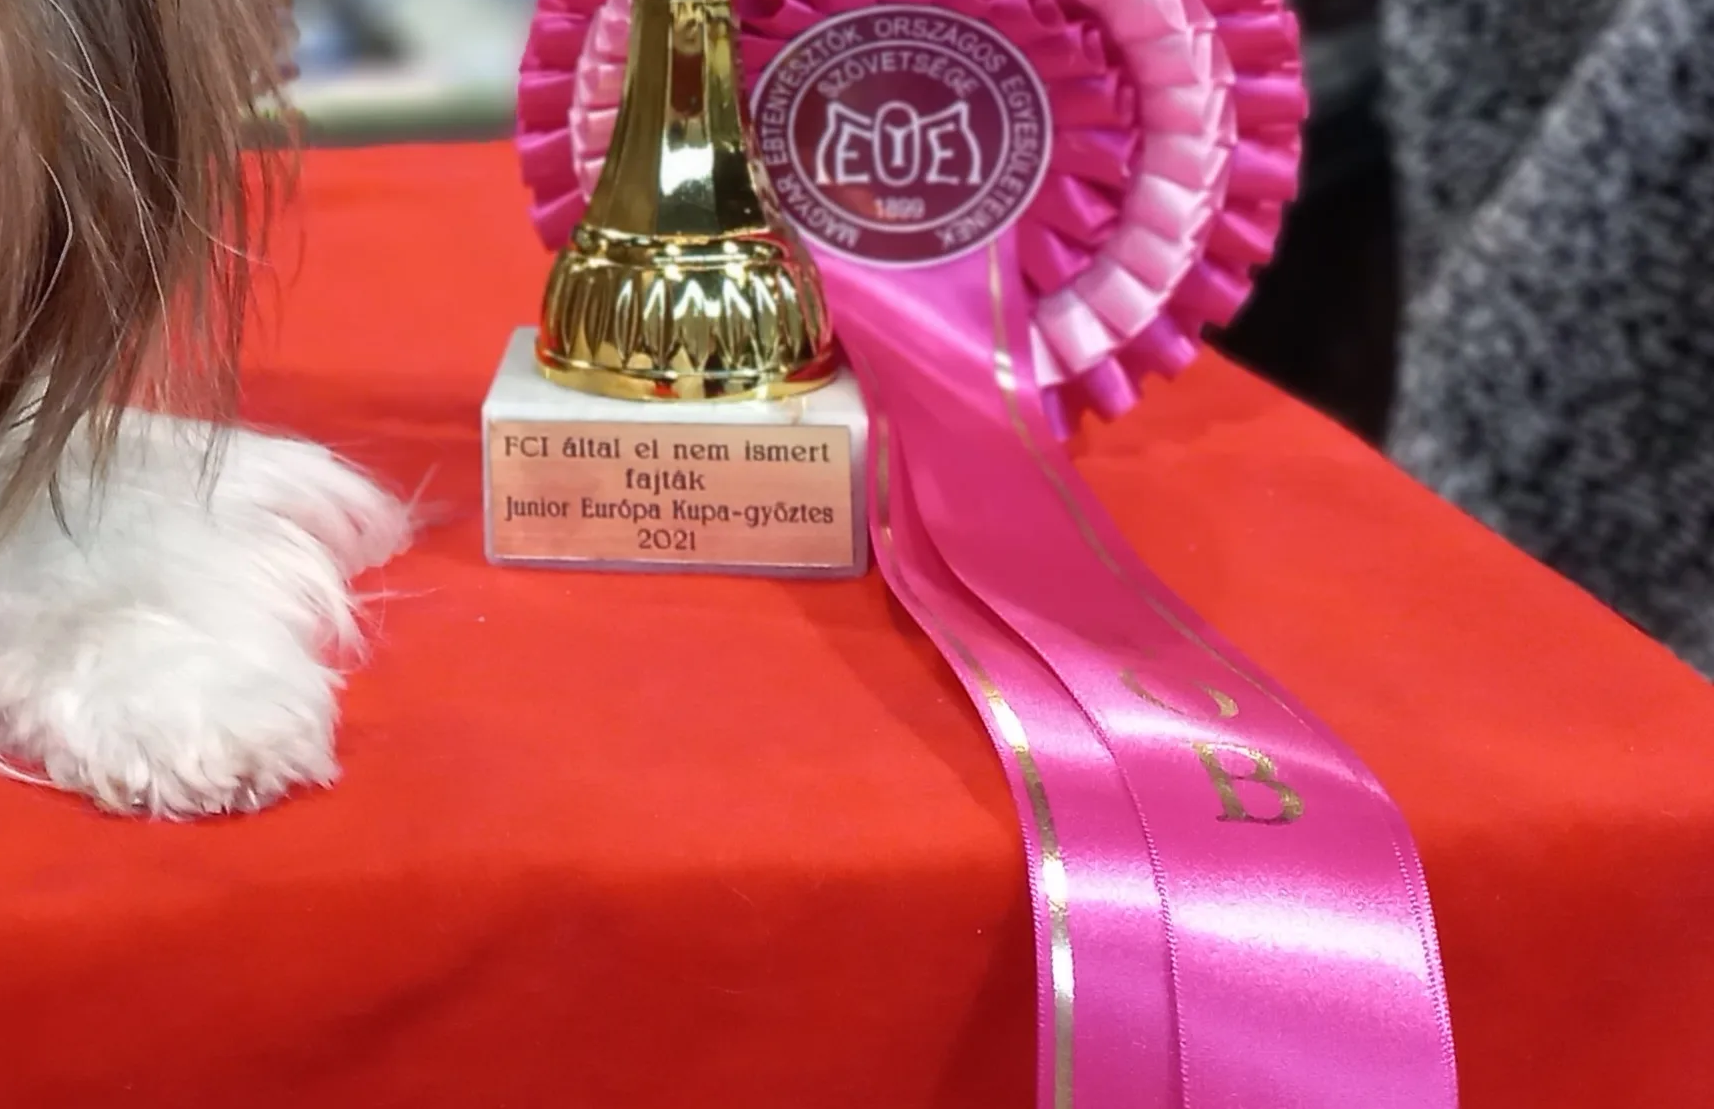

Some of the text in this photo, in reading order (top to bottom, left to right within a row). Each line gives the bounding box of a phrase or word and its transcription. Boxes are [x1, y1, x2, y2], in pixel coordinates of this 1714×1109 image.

[776, 172, 862, 249] MAGYAR
[873, 15, 1008, 74] ORSZÁGOS
[503, 435, 831, 463] FCI által el nem ismert
[624, 467, 706, 496] fajták
[504, 496, 834, 528] Junior Európa Kupa-győztes
[636, 528, 697, 552] 2021
